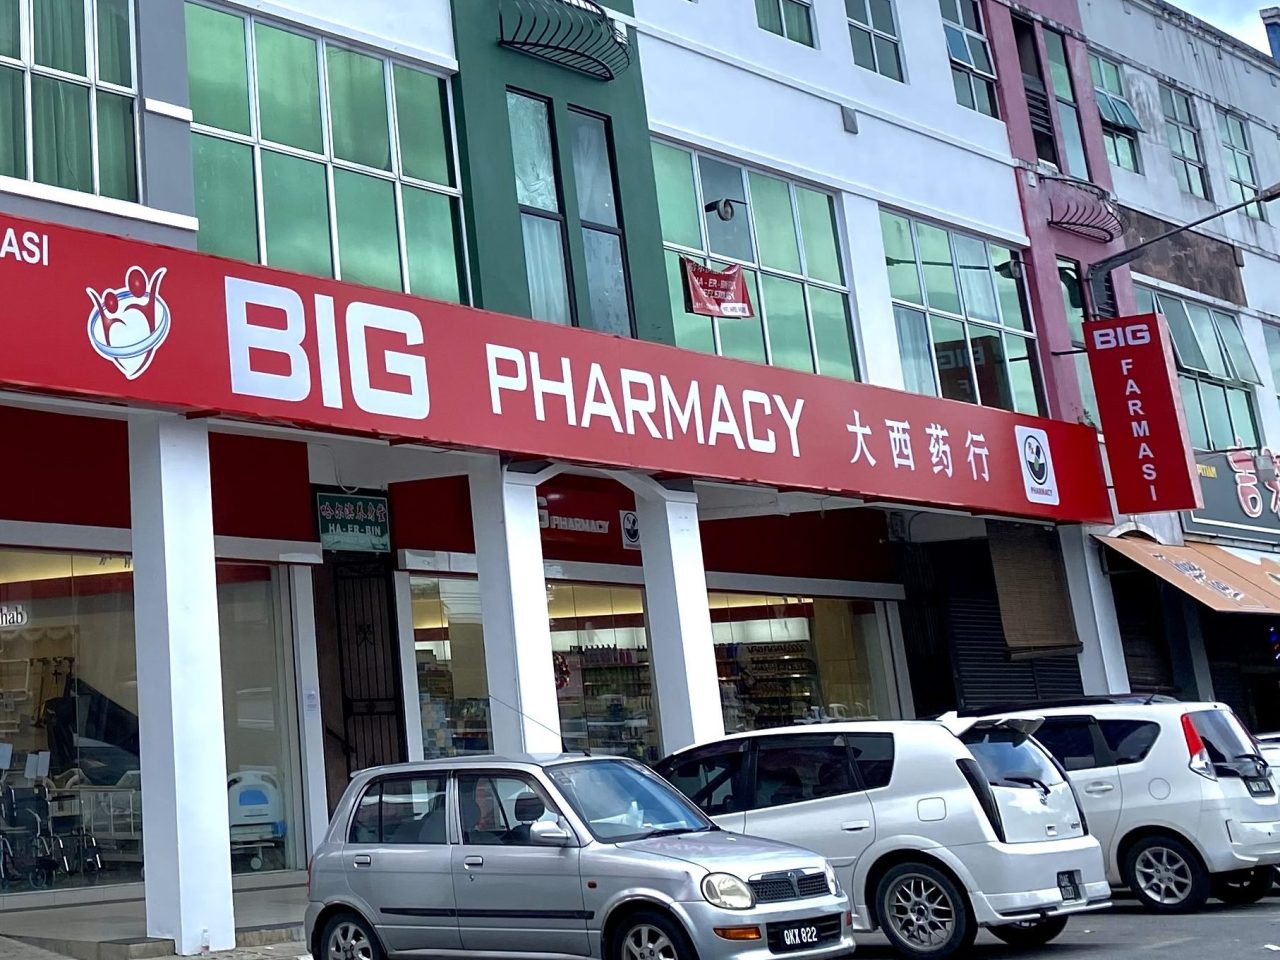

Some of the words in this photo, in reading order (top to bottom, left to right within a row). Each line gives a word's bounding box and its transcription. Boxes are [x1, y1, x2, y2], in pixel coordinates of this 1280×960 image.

[1093, 324, 1151, 350] BIG
[224, 275, 431, 421] BIG
[485, 342, 805, 458] PHARMACY
[846, 409, 990, 482] 大西药行
[1121, 359, 1157, 502] FARMASI
[550, 515, 609, 534] PHARMACY
[801, 926, 818, 942] 822
